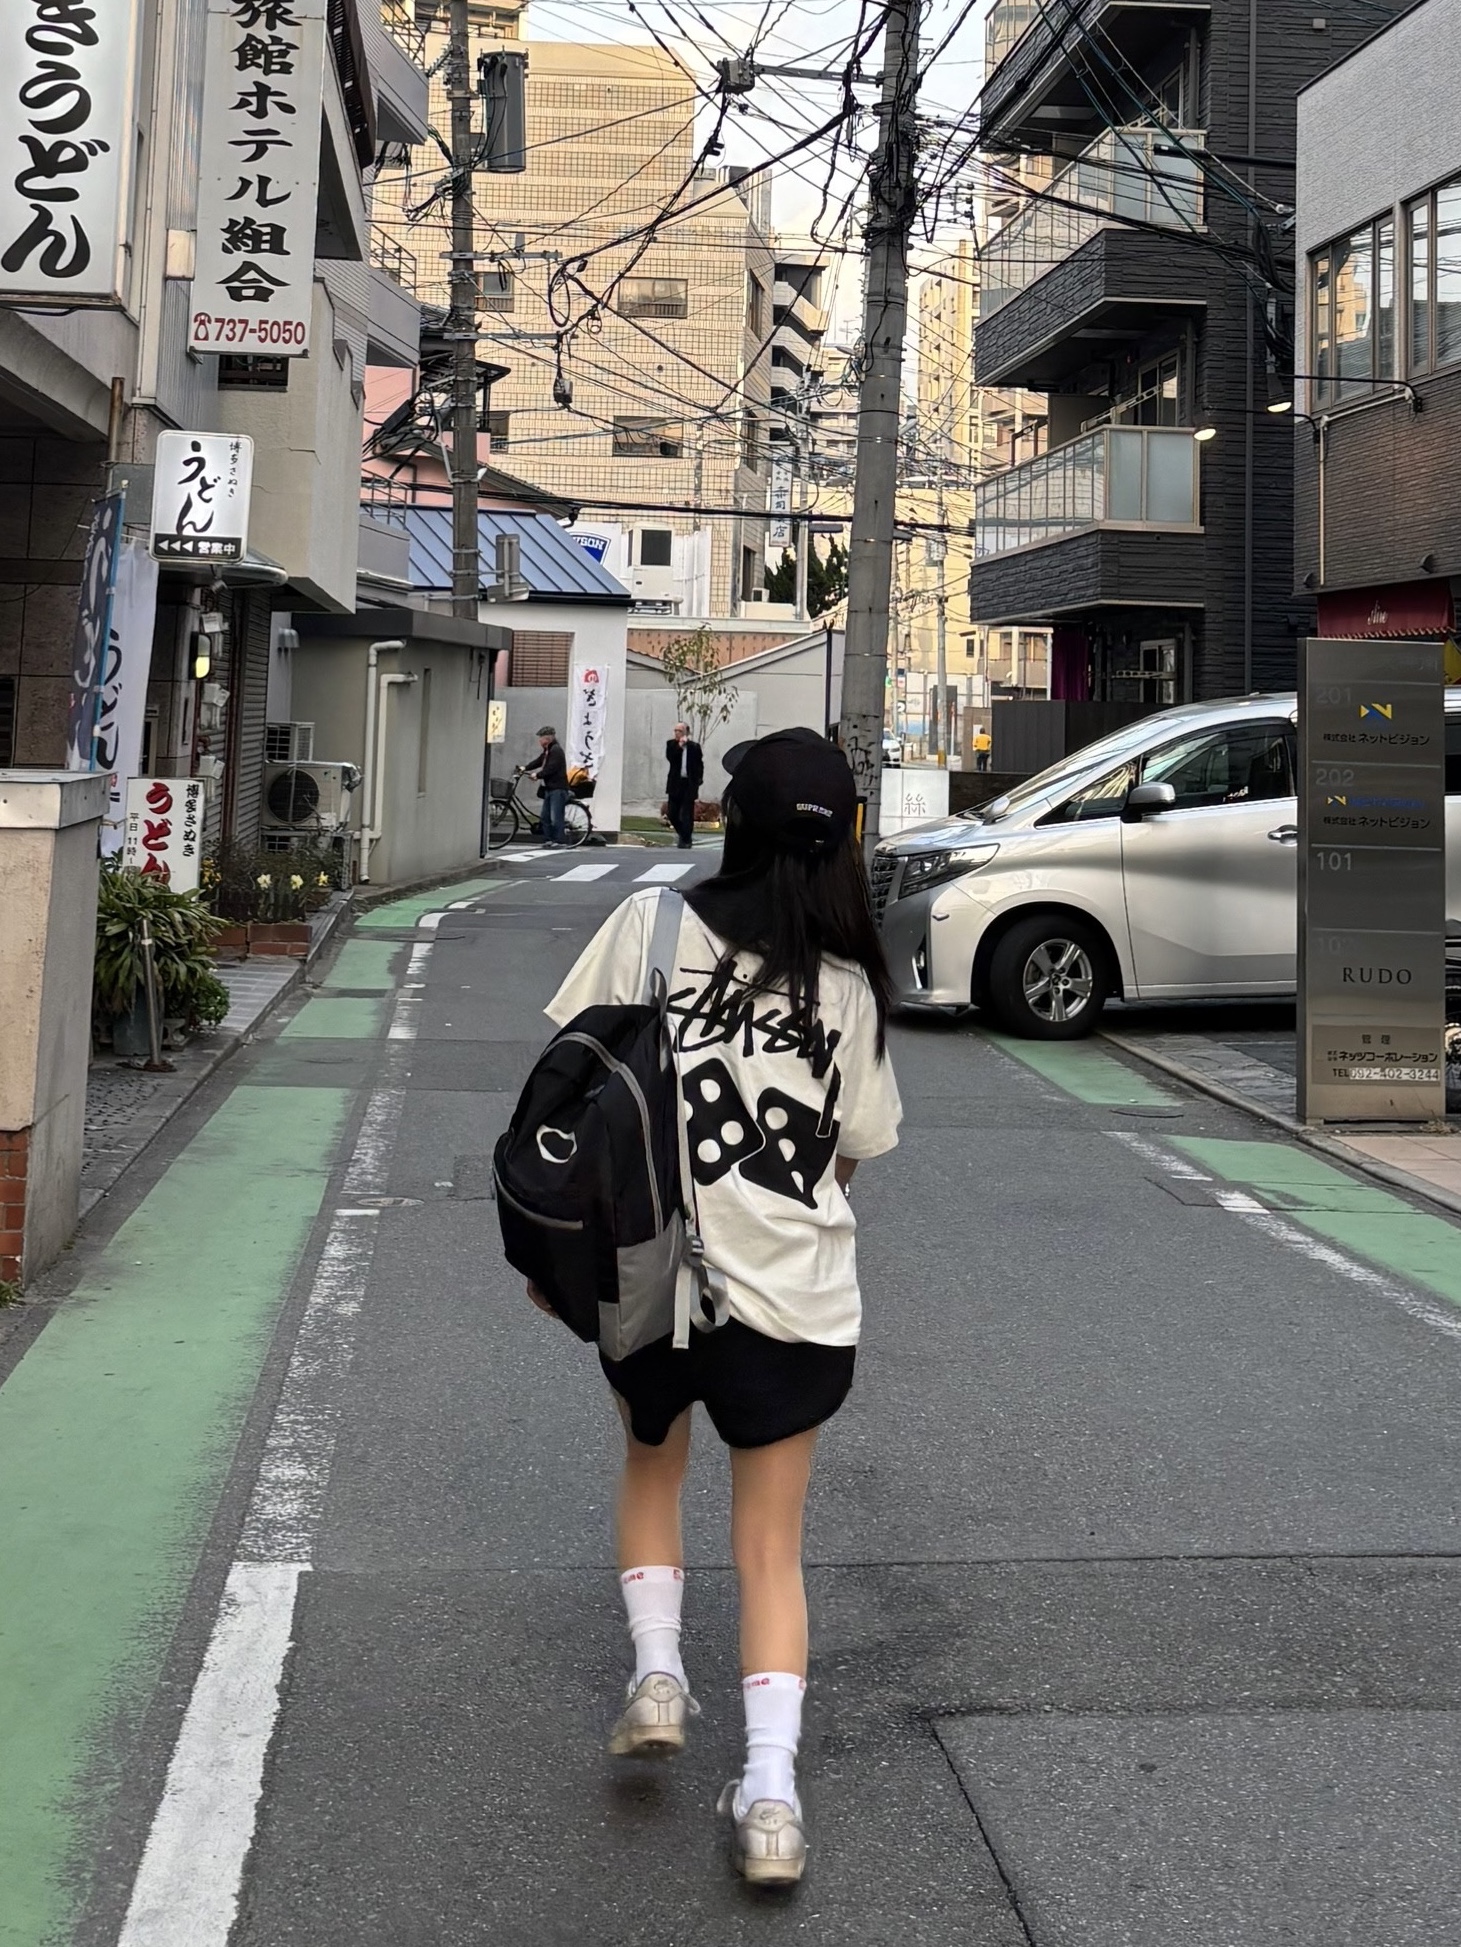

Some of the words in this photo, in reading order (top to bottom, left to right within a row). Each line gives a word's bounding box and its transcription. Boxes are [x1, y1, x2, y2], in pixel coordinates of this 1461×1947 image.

[214, 0, 303, 303] 旅館ホテル組合
[214, 317, 306, 345] 737-5050
[176, 440, 221, 536] うどん
[197, 541, 236, 556] 営業中
[1315, 768, 1355, 786] 202
[142, 782, 174, 885] うどん
[1316, 852, 1352, 870] 101
[1342, 967, 1412, 985] RUDO
[1332, 1068, 1349, 1077] TEL
